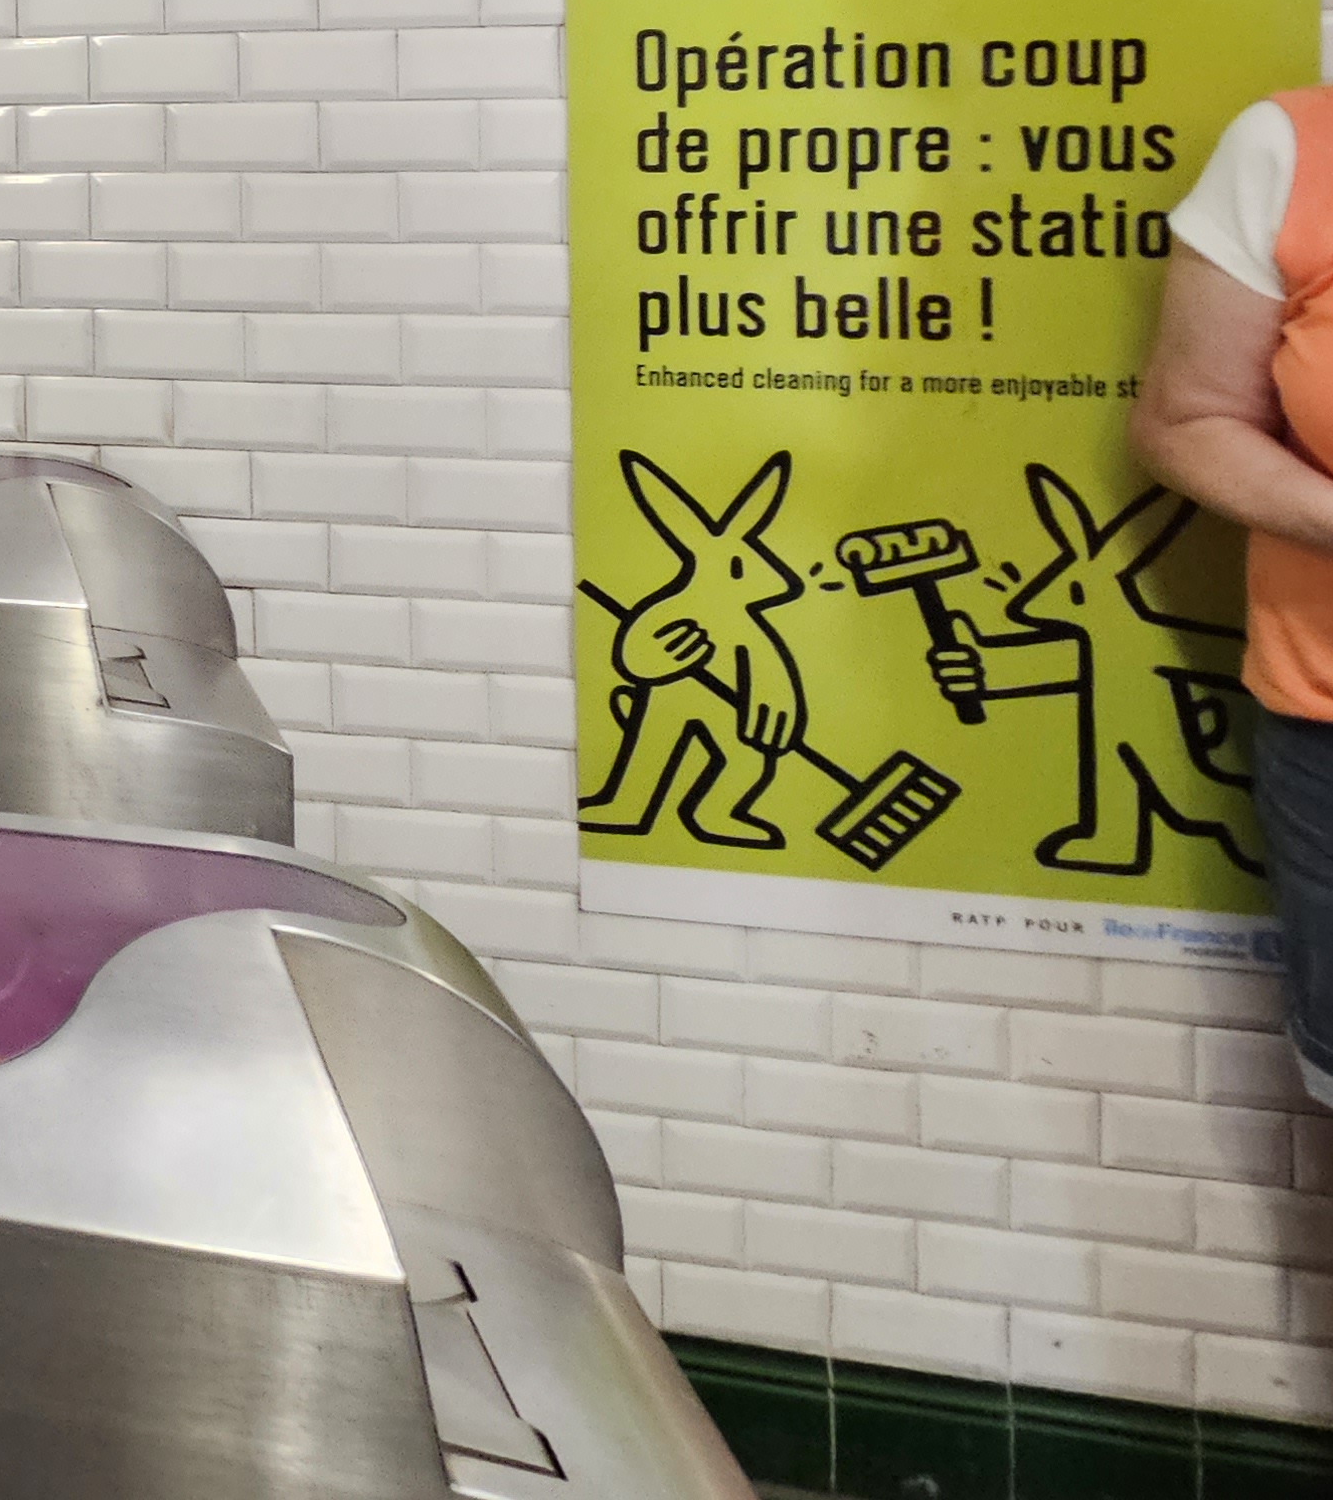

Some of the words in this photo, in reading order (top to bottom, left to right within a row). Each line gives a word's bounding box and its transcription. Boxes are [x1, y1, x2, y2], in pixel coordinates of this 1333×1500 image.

[636, 26, 951, 108] Opération
[982, 38, 1147, 105] coup
[636, 110, 708, 174] de
[738, 125, 951, 191] propre
[1020, 123, 1178, 174] vous
[637, 191, 798, 256] offrir
[825, 209, 941, 258] une
[972, 192, 1174, 260] statio
[637, 273, 767, 354] plus
[794, 274, 952, 343] belle
[979, 275, 994, 343] !
[635, 364, 745, 390] Enhanced
[751, 367, 852, 398] cleaning
[859, 369, 891, 393] for
[899, 374, 914, 393] a
[921, 375, 983, 395] more
[990, 372, 1108, 402] enjoyable
[950, 911, 1007, 928] RATP
[1023, 916, 1085, 935] POUR
